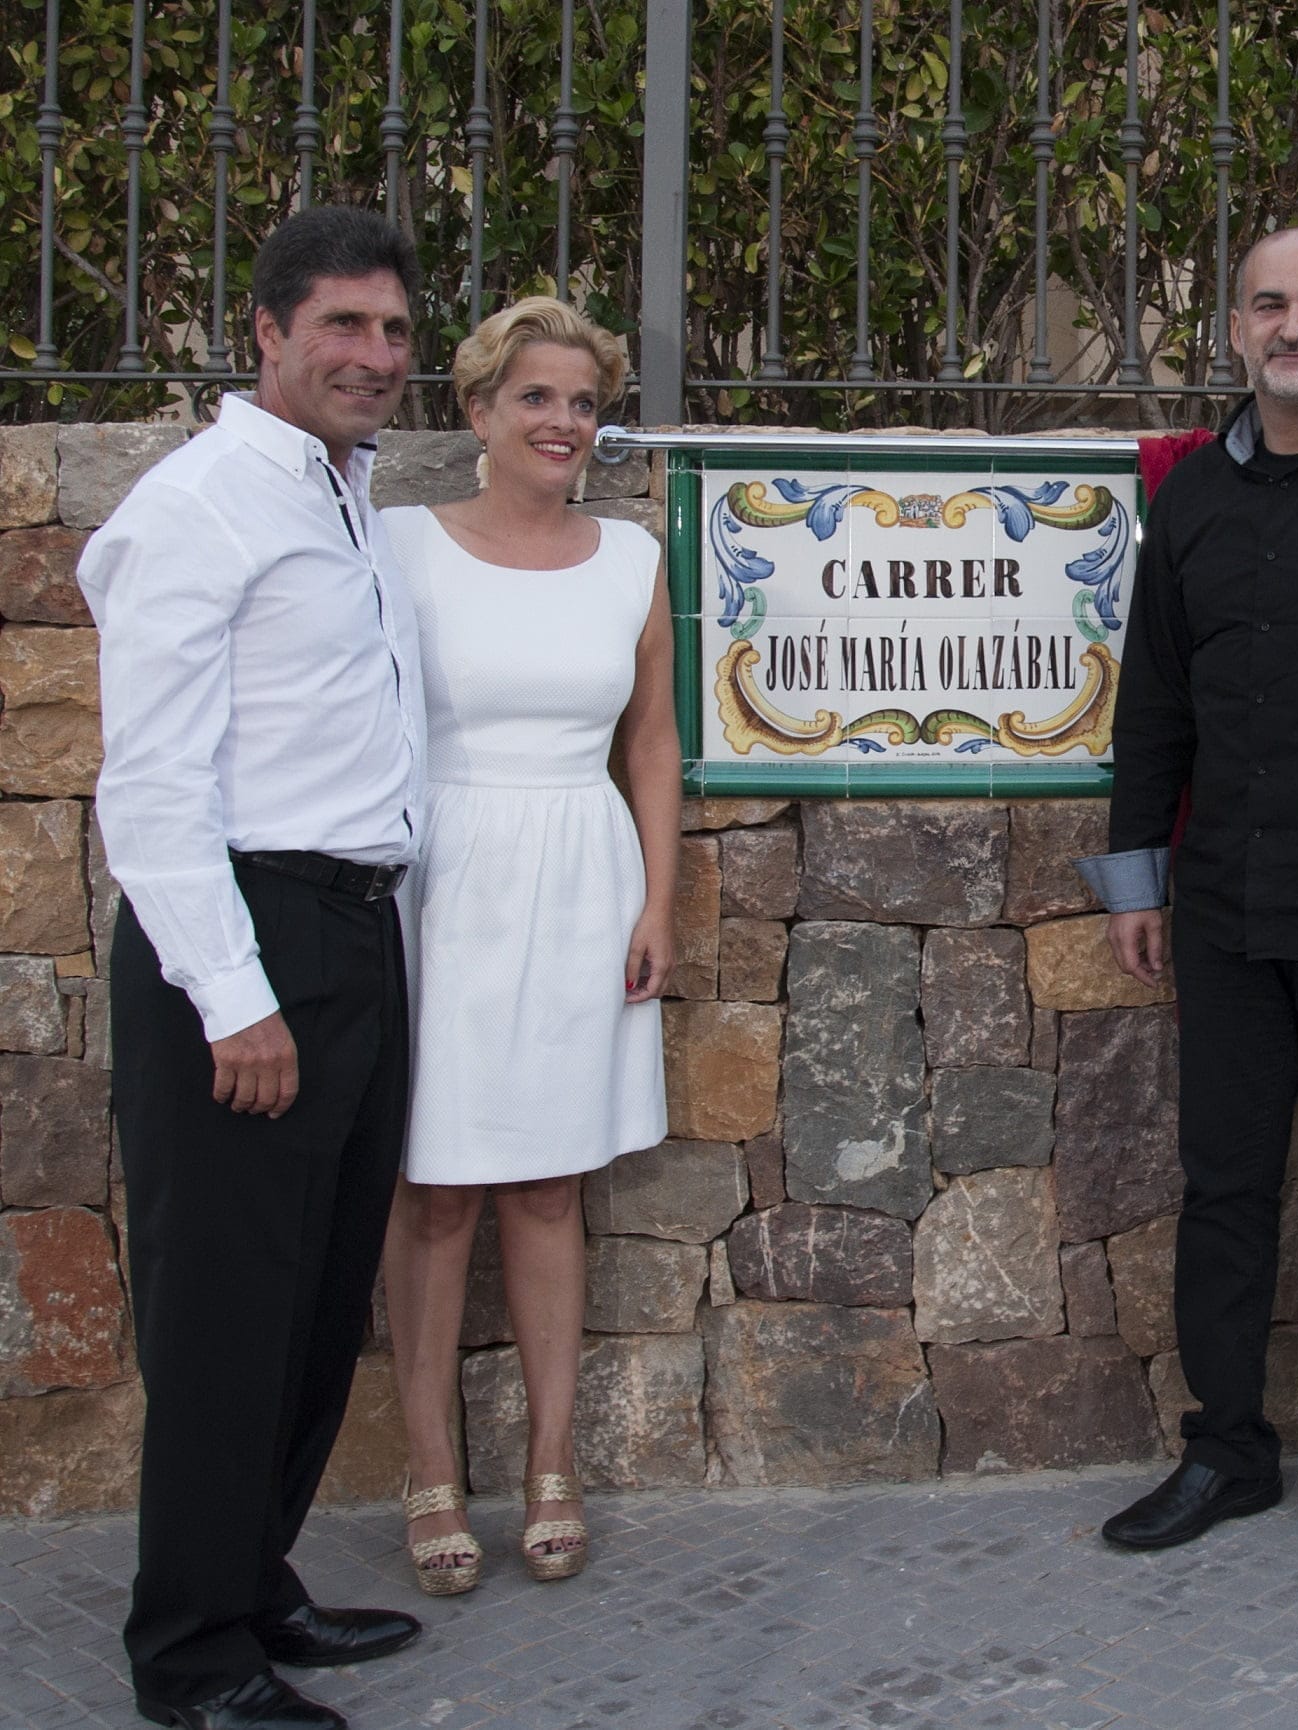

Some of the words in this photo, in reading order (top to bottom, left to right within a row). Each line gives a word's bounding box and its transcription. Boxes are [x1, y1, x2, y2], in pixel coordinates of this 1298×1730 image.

[821, 558, 1023, 600] CARRER
[766, 619, 829, 692] JOSÉ
[839, 619, 927, 692] MARÍA
[938, 619, 1077, 691] OLAZÁBAL
